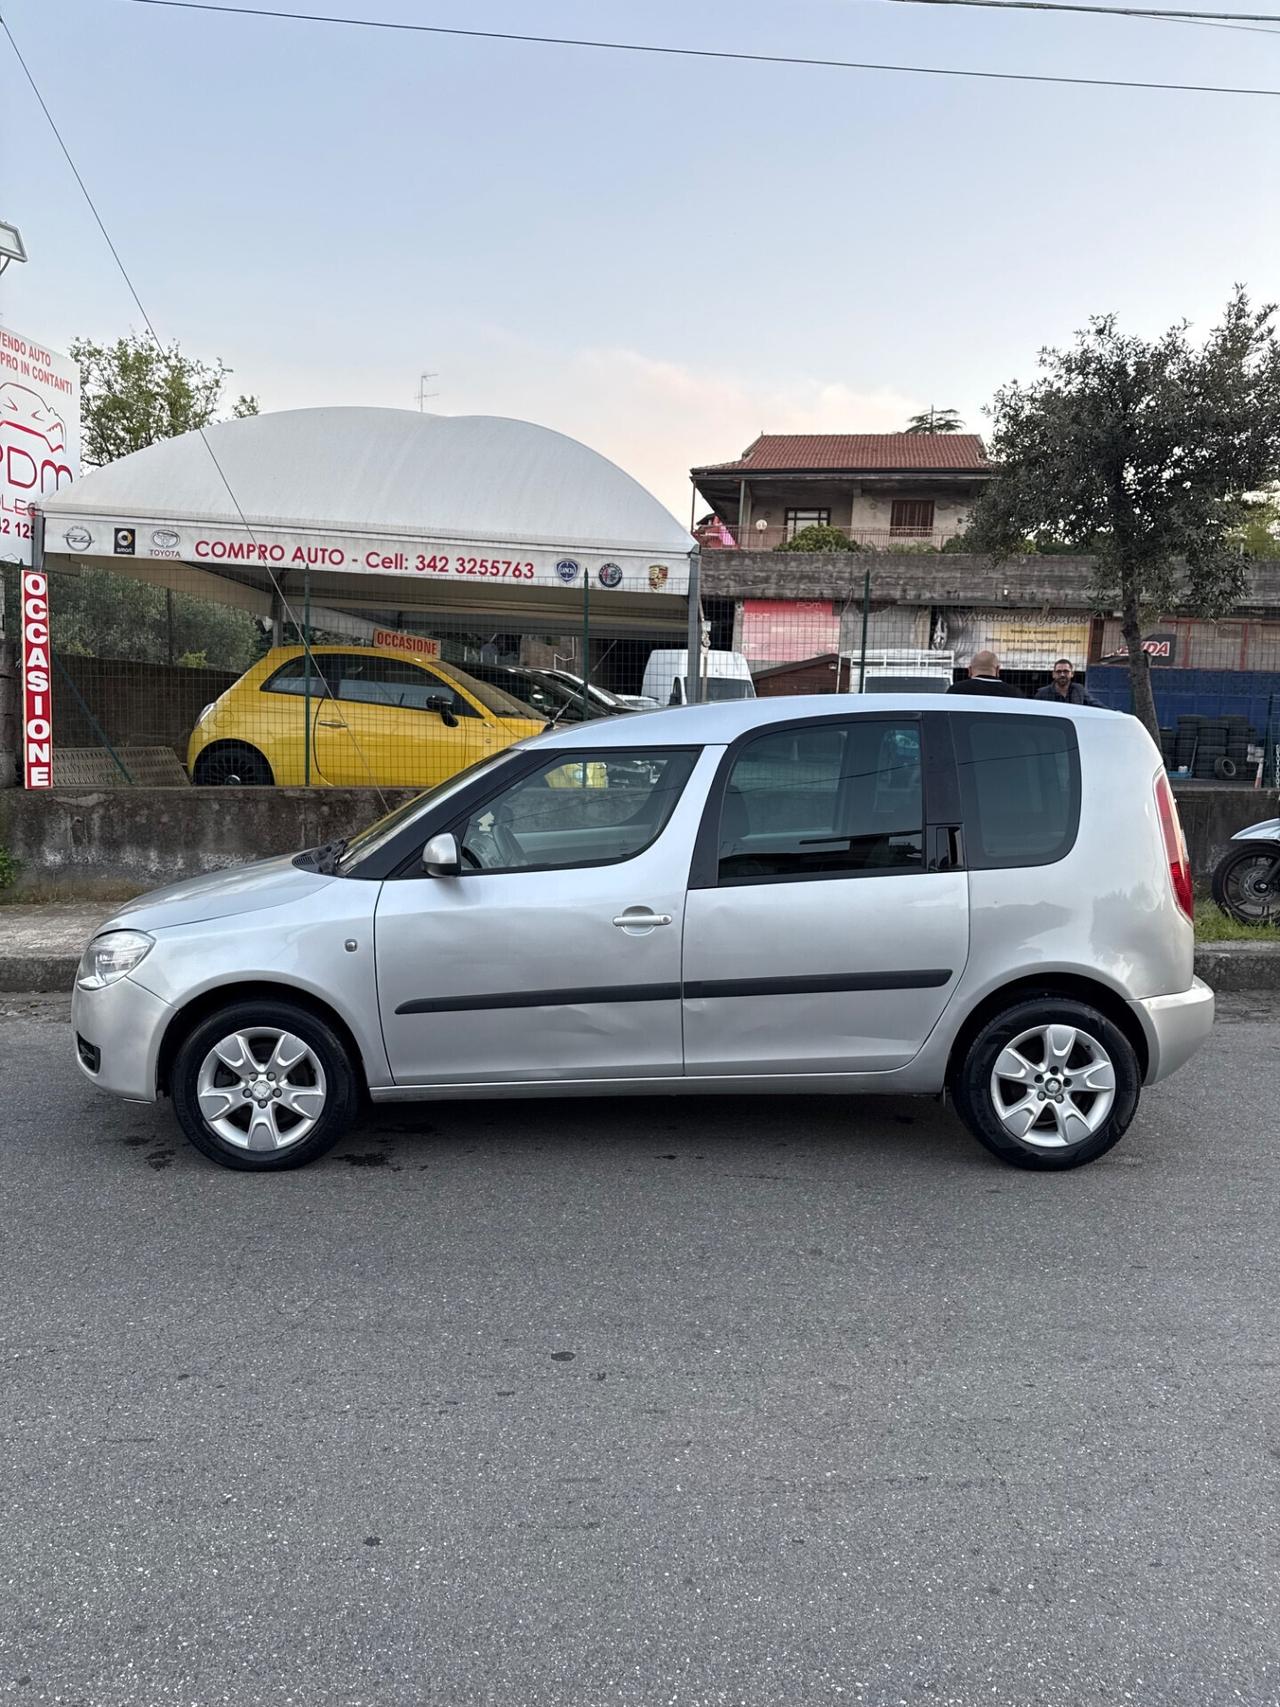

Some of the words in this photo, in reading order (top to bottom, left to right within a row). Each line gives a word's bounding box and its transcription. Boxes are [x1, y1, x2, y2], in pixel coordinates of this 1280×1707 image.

[29, 345, 51, 367] AUTO
[21, 360, 30, 376] IN
[32, 366, 73, 395] CONTANTI
[149, 548, 181, 559] TOYOTA
[195, 539, 285, 561] COMPRO
[291, 545, 345, 566] AUTO
[365, 551, 409, 571] Cell:
[415, 554, 449, 573] 342
[455, 557, 535, 580] 3255763
[376, 632, 437, 656] OCCASIONE
[24, 574, 50, 787] OCCASIONE
